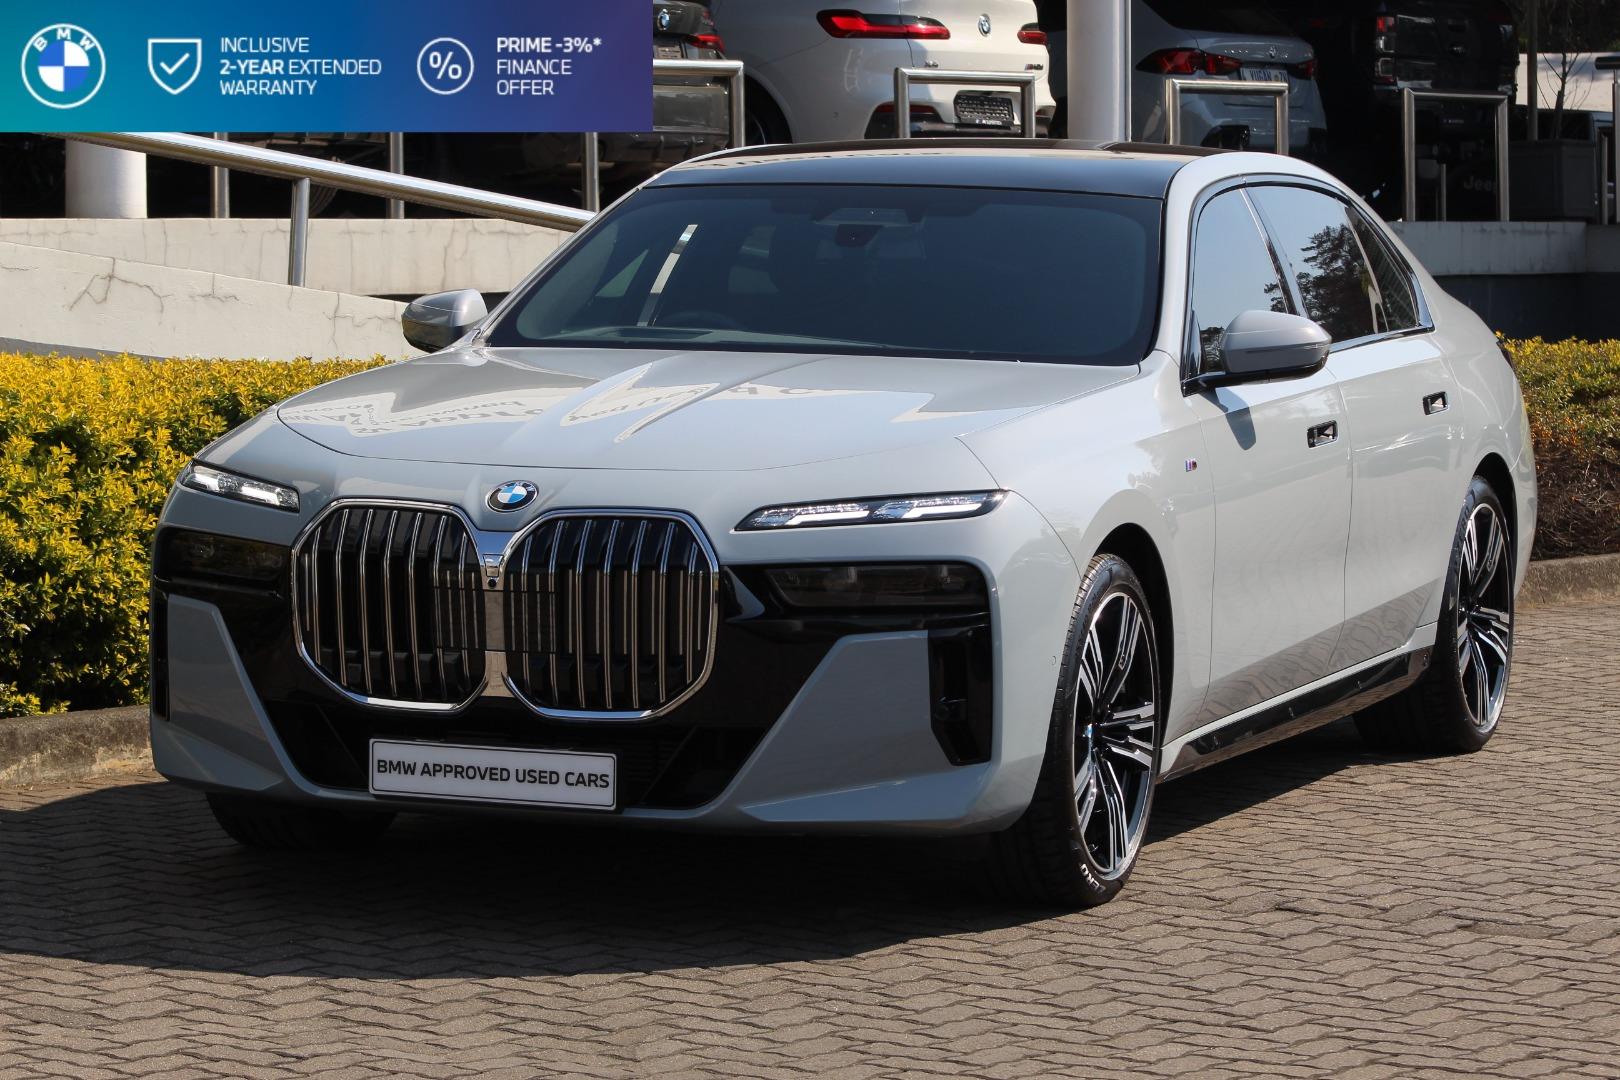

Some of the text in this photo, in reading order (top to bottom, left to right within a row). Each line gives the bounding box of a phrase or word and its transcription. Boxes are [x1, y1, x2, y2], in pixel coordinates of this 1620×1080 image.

[377, 759, 610, 788] BMW APPROVED USED CARS
